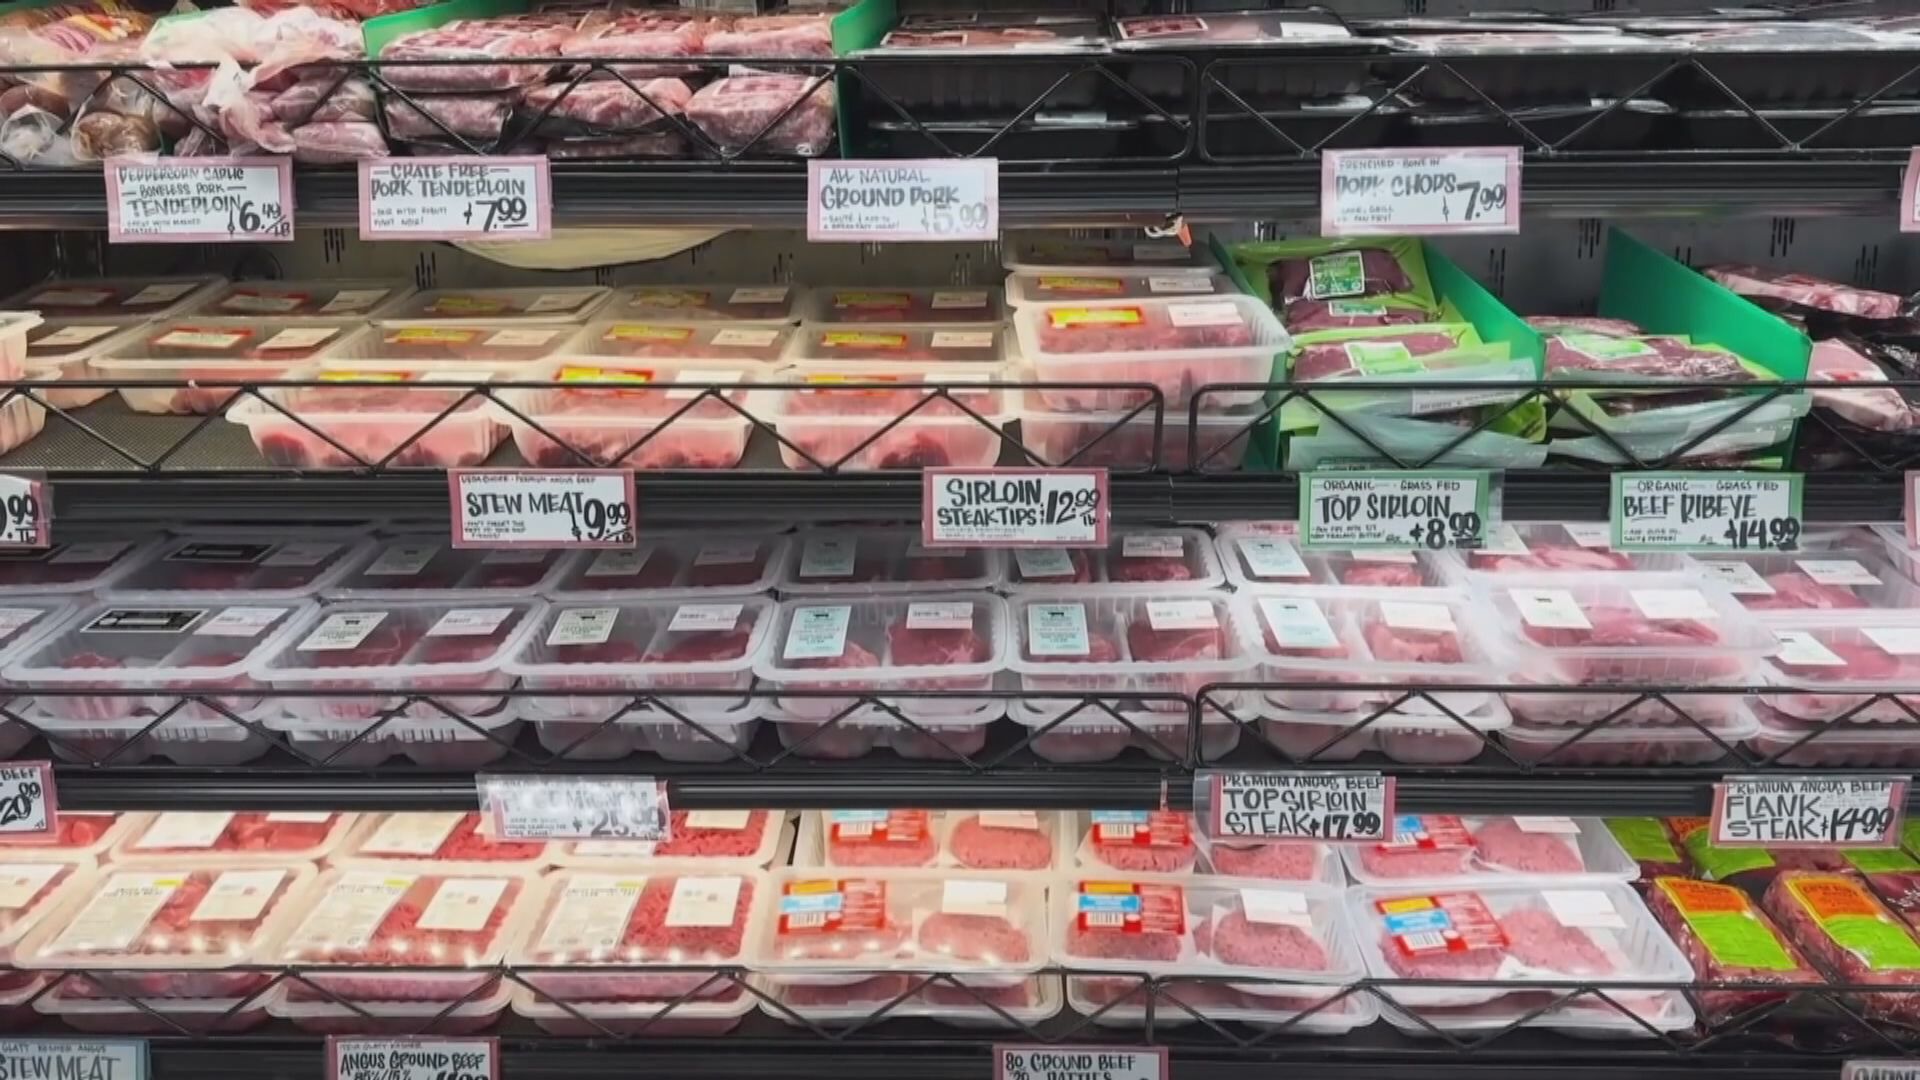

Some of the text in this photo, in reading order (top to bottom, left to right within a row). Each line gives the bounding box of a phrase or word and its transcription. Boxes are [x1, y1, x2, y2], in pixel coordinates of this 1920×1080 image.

[203, 166, 244, 182] GARLIC
[391, 162, 489, 180] CRATE FREE
[860, 168, 932, 184] NATURAL
[140, 182, 225, 199] BONELESS PORK
[371, 178, 525, 201] PORK TENDERLOIN
[1390, 172, 1457, 198] CHOPS
[126, 194, 241, 218] TENDERLOIN
[820, 185, 961, 211] GROUND PORK
[1442, 180, 1508, 223] $7.99
[463, 197, 528, 232] $7.99
[945, 478, 1043, 507] SIRLOIN
[1323, 480, 1461, 492] ORGANIC GRASS FED
[1638, 480, 1780, 493] ORGANIC GRASS FED
[466, 491, 585, 518] STEW MEAT
[1315, 492, 1451, 524] TOP SIRLOIN
[1623, 493, 1758, 523] BEEF RIBEYE
[937, 506, 1037, 527] STEAK TIPS
[1409, 511, 1482, 551] $8.99
[1723, 517, 1801, 551] $14.99
[1, 768, 36, 781] BEEF
[1223, 775, 1384, 790] PREMIUM ANGUS BEEF
[1223, 789, 1280, 811] TOP
[1280, 789, 1368, 812] SIRLOIN
[1726, 782, 1889, 796] PREMIUM ANGUS BEEF
[1726, 794, 1821, 820] FLANK
[1224, 811, 1381, 840] STEAK $17.99
[1727, 818, 1820, 840] STEAK
[2, 1043, 30, 1053] GLATT
[55, 1055, 121, 1080] MEAT
[340, 1050, 486, 1077] ANGUS GROUND BEEF
[1005, 1052, 1136, 1072] 80 GROUND BEEF
